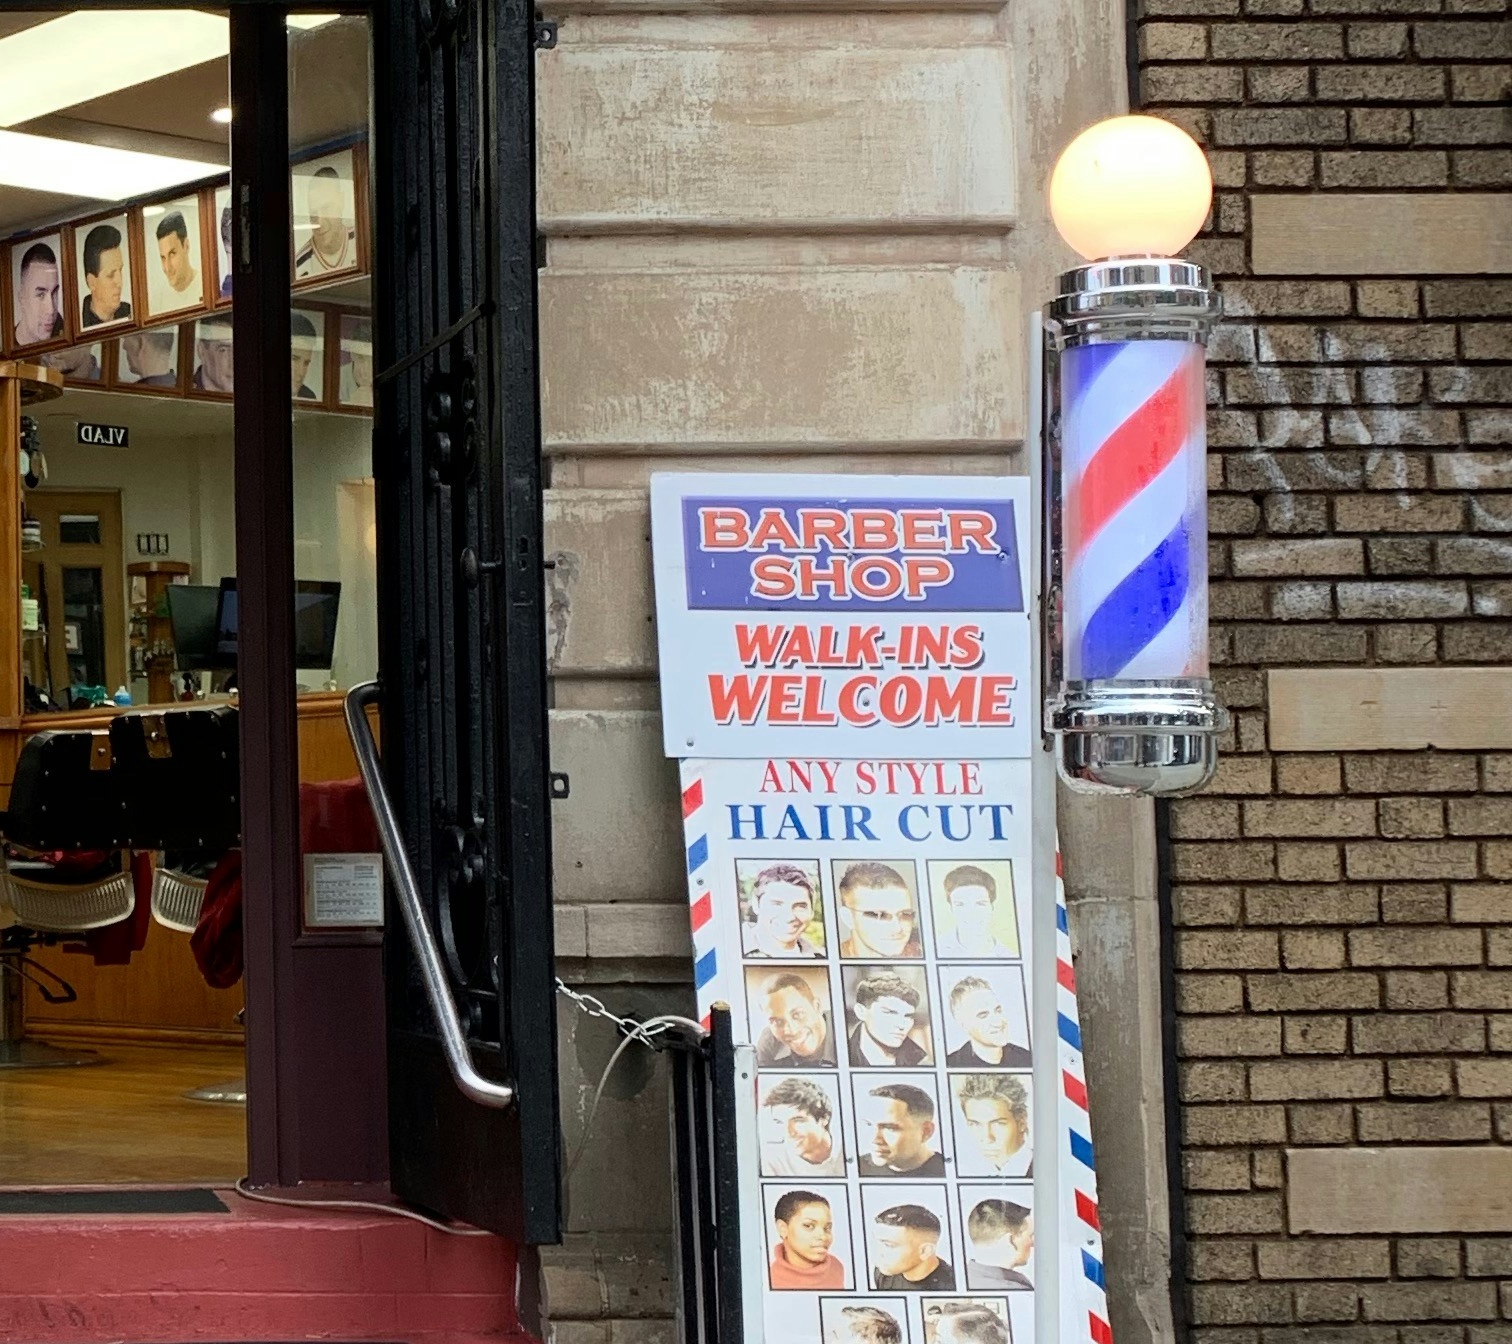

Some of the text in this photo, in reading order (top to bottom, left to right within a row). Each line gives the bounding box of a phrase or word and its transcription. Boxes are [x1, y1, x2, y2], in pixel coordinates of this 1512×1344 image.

[699, 508, 999, 554] BARBER
[752, 555, 953, 601] SHOP
[735, 624, 985, 669] WALK-INS
[707, 674, 1017, 726] WELCOME
[759, 759, 984, 795] ANY STYLE
[725, 804, 1014, 841] HAIR CUT
